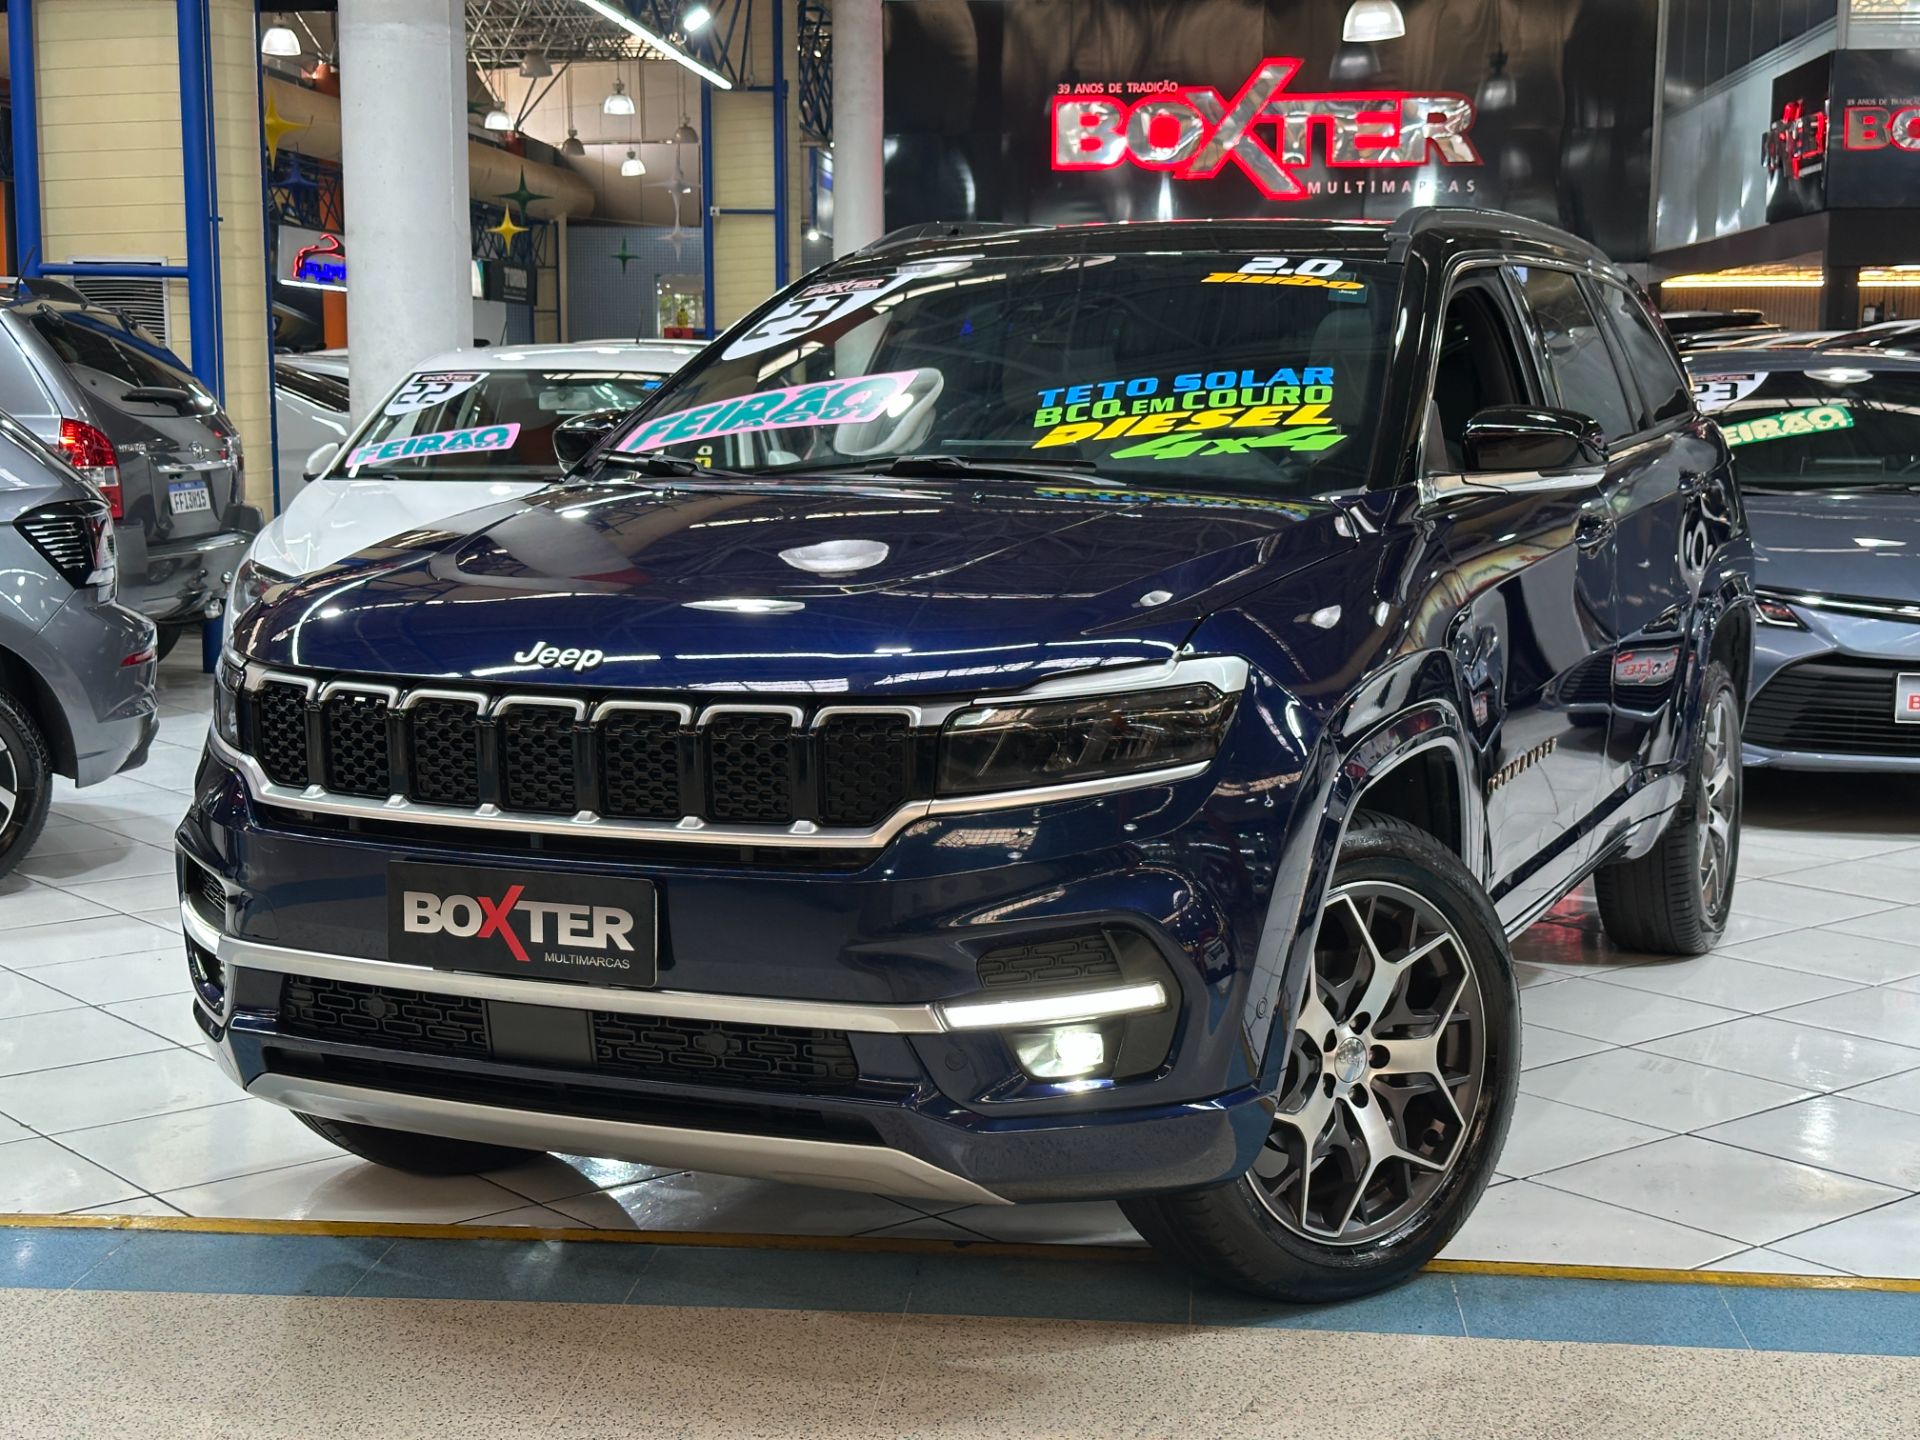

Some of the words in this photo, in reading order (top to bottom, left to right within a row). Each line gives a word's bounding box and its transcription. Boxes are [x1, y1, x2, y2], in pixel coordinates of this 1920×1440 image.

[1057, 84, 1071, 94] 39
[1074, 83, 1104, 94] ANOS
[1108, 83, 1123, 93] DE
[1126, 80, 1179, 94] TRADIÇÃO
[1052, 57, 1484, 200] BOXTER
[1306, 180, 1476, 194] MULTIMARCAS
[1237, 257, 1344, 277] 2.0
[392, 383, 454, 405] 22
[1037, 377, 1159, 408] TETO
[1173, 367, 1335, 394] SOLAR
[1131, 397, 1175, 415] EM
[1182, 385, 1333, 411] COURO
[1032, 405, 1334, 449] DIESEL
[1722, 407, 1847, 446] EIRÃO
[514, 641, 603, 672] Jeep
[404, 885, 635, 962] BOXTER
[544, 952, 631, 969] MULTIMARCAS
